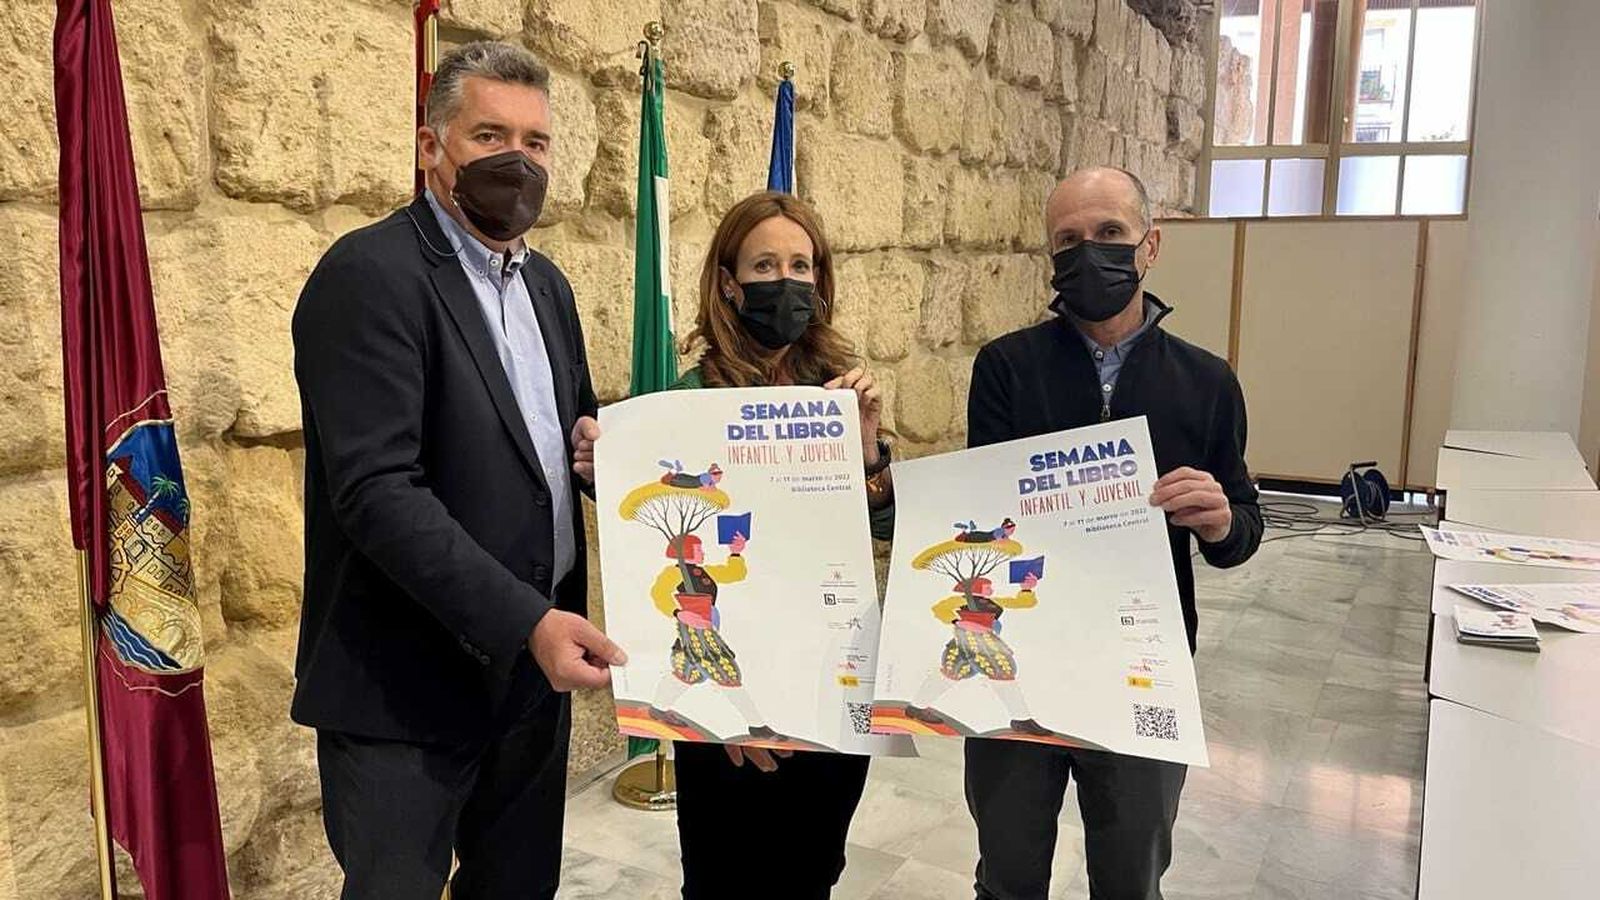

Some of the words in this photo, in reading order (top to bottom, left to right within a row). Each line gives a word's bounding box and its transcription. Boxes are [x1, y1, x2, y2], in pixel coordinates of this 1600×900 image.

[740, 400, 842, 420] SEMANA
[727, 424, 769, 440] DEL
[775, 420, 844, 440] LIBRO
[727, 444, 780, 465] INFANTIL
[786, 444, 793, 464] Y
[800, 442, 848, 463] JUVENIL
[1029, 438, 1135, 472] SEMANA
[1019, 474, 1061, 495] DEL
[1066, 459, 1138, 486] LIBRO
[791, 484, 826, 493] Biblioteca
[827, 483, 852, 492] Central
[1020, 492, 1074, 516] INFANTIL
[1079, 489, 1086, 507] Y
[1094, 480, 1144, 505] JUVENIL
[1085, 521, 1121, 533] Biblioteca
[1122, 516, 1149, 527] Central
